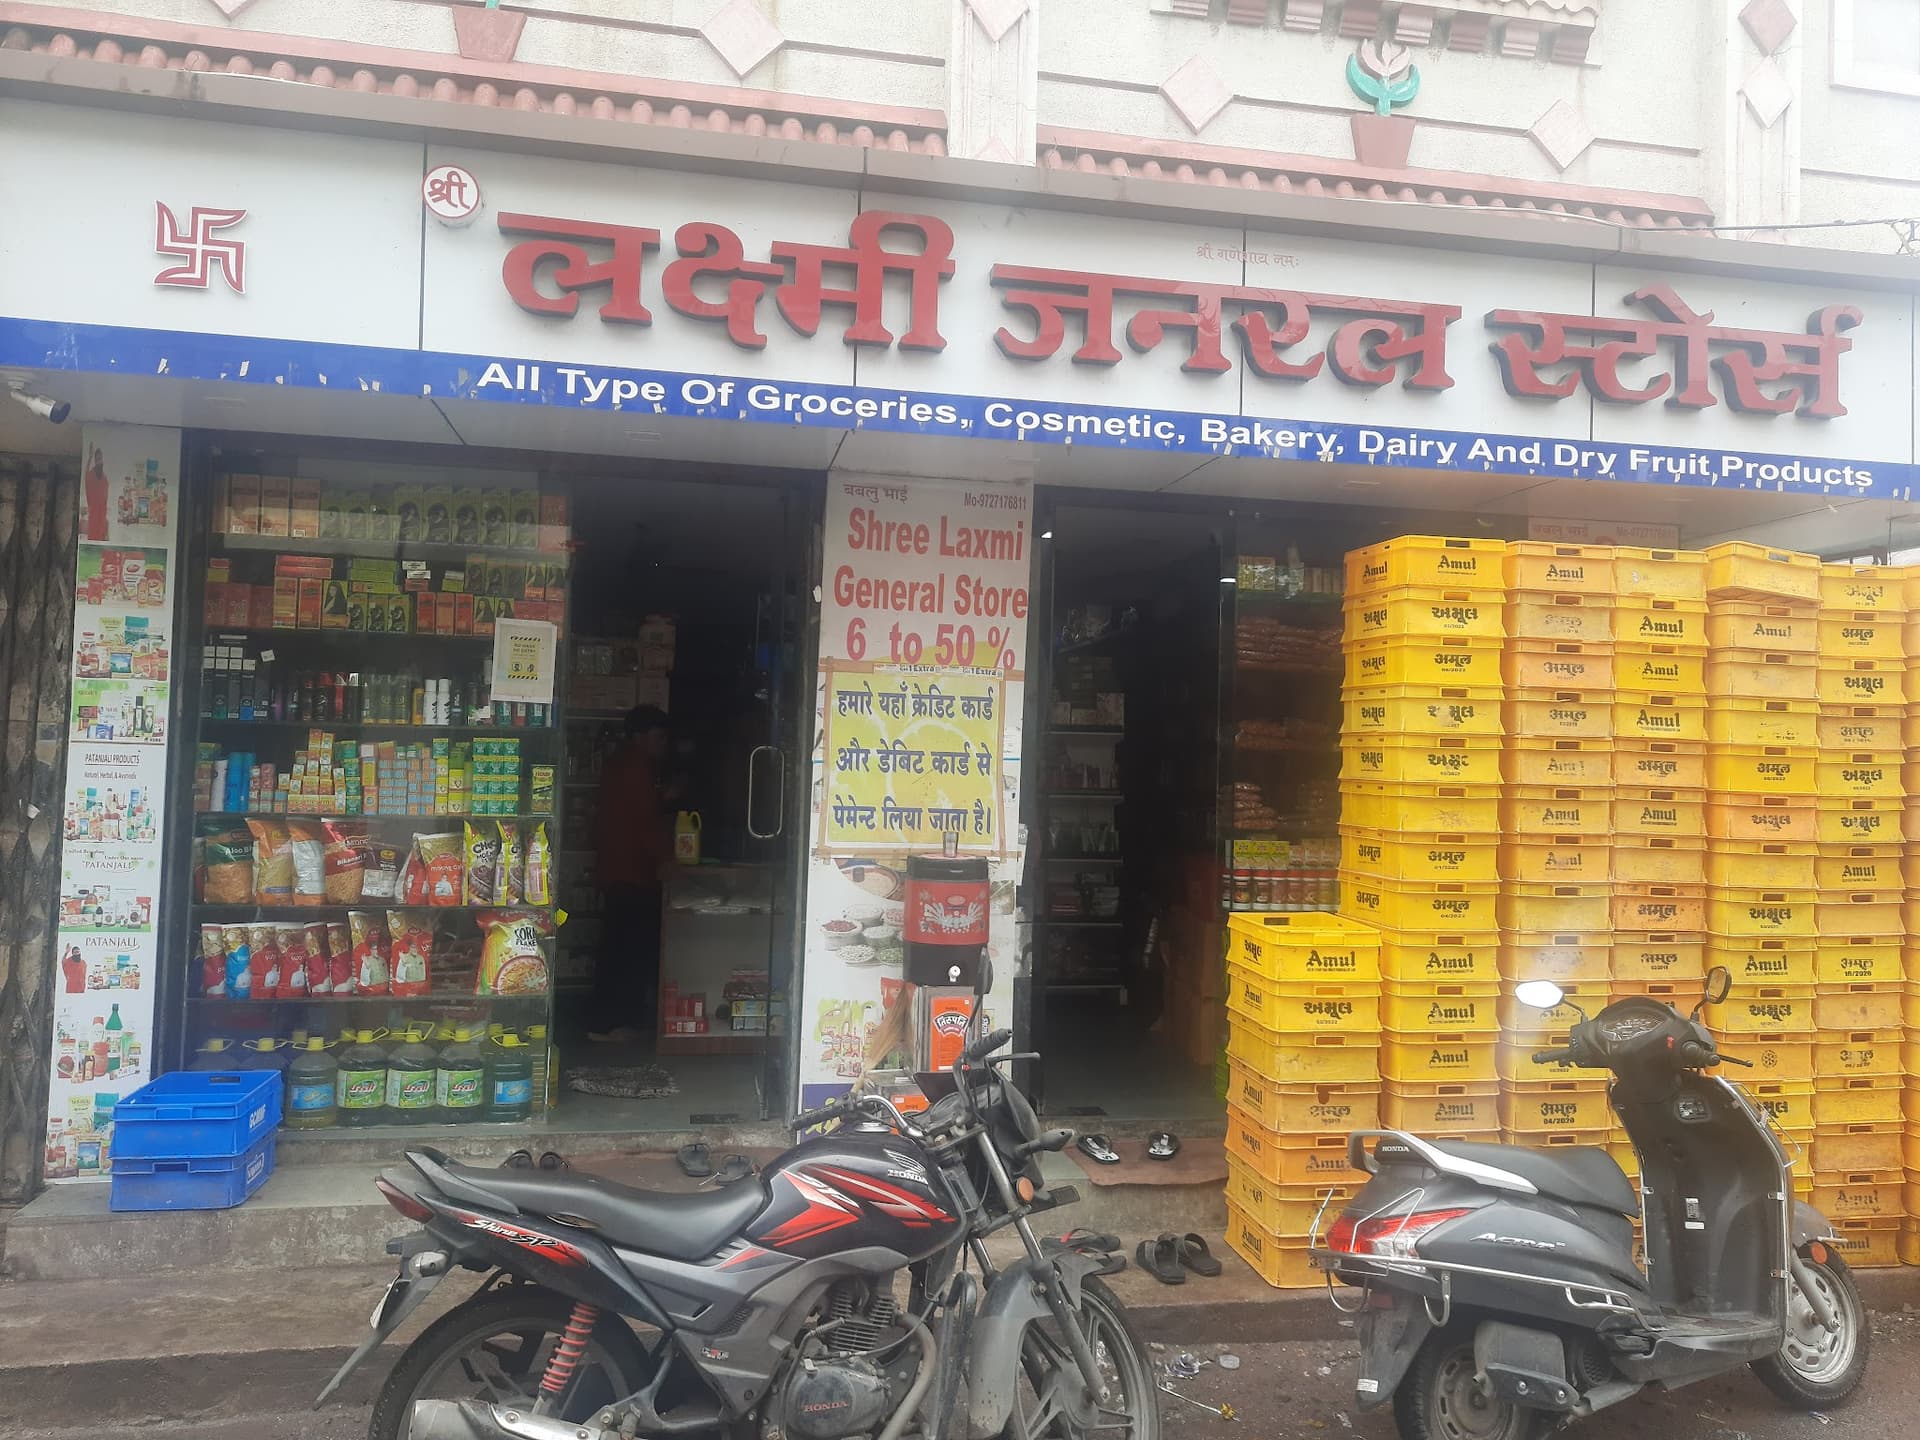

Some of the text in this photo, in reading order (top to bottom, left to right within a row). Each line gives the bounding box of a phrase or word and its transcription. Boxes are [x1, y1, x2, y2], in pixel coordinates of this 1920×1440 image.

[427, 170, 472, 210] श्री
[1196, 243, 1213, 259] श्री
[497, 209, 1865, 419] लक्ष्मी जनरल स्टोर्स
[477, 363, 540, 392] All
[556, 368, 666, 404] Type
[681, 379, 734, 407] Of
[984, 402, 1186, 444] Cosmetic,
[1201, 419, 1345, 456] Bakery,
[1358, 429, 1457, 464] Dairy
[1467, 438, 1541, 465] And
[1554, 443, 1617, 474] Dry
[1630, 449, 1710, 476] Fruit
[1721, 456, 1873, 487] Products
[843, 484, 908, 504] बबलु भाई
[848, 507, 1024, 561] Shree Laxmi
[1363, 560, 1388, 577] Amul
[1437, 555, 1477, 571] Amul
[1546, 564, 1584, 579] Amul
[834, 564, 1028, 618] General Store
[1431, 607, 1478, 625] અમૂલ
[1639, 616, 1684, 634] Amul
[847, 617, 1016, 670] 6 to 50 %
[1842, 628, 1875, 641] अमूल
[1434, 653, 1473, 668] अमूल
[1543, 661, 1585, 676] अमूल
[1642, 661, 1680, 677] Amul
[1844, 677, 1884, 694] અમૂલ
[837, 680, 994, 720] हमारे यहाँ क्रेडिट कार्ड
[1550, 708, 1587, 722] अमूल
[1637, 708, 1681, 728] Amul
[85, 754, 140, 765] PATANJALI PRODUCTS
[836, 737, 870, 772] और
[877, 738, 925, 774] डेबिट
[931, 741, 971, 776] कार्ड
[1638, 760, 1677, 776] अमूल
[1757, 763, 1791, 777] अमूल
[1842, 769, 1883, 785] અમૂલ
[833, 794, 876, 830] पेमेन्ट
[881, 796, 923, 831] लिया
[928, 807, 968, 832] जाता
[1542, 807, 1580, 822] Amul
[1640, 806, 1677, 821] Amul
[1358, 844, 1381, 862] अमूल
[1428, 850, 1466, 864] अमूल
[1842, 864, 1876, 878] Amul
[1356, 891, 1380, 909] अमूल
[1432, 899, 1470, 913] अमूल
[1749, 907, 1792, 925] અમૂલ
[85, 937, 140, 951] PATANJALI
[1305, 950, 1357, 968] Amul
[1425, 951, 1475, 969] Amul
[1745, 954, 1788, 972] Amul
[1244, 984, 1263, 1005] Amul
[1303, 1001, 1353, 1020] અમૂલ
[1427, 1002, 1475, 1020] Amul
[1749, 1003, 1792, 1022] અમૂલ
[1429, 1049, 1469, 1065] Amul
[1243, 1079, 1263, 1105] Amul
[1434, 1102, 1475, 1117] Amul
[1540, 1102, 1577, 1117] अमूल
[887, 1169, 929, 1185] HONDA
[461, 1219, 519, 1238] Shine
[1242, 1224, 1262, 1252] Amul
[804, 1400, 848, 1413] HONDA
